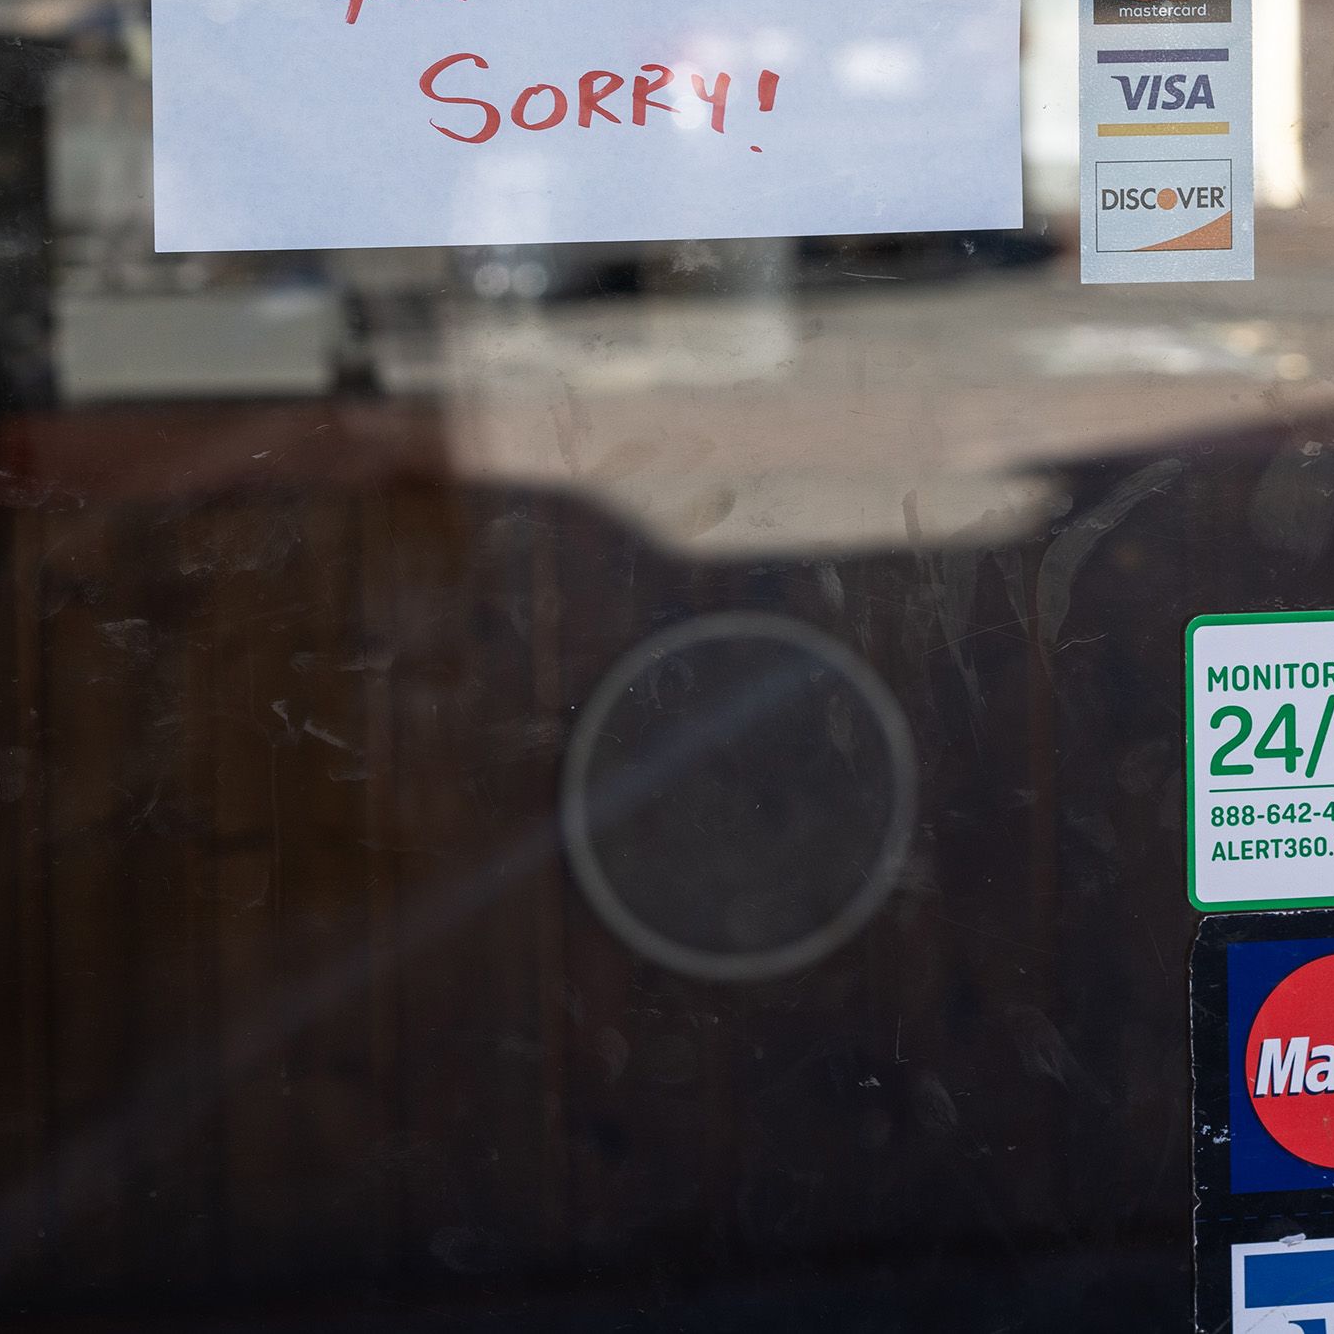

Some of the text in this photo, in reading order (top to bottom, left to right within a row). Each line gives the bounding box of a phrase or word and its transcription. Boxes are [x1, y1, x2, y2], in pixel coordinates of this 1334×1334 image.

[1119, 3, 1207, 18] mastercard
[419, 53, 780, 153] SORRY!
[1111, 74, 1215, 110] VISA
[1101, 186, 1226, 211] DISCOVER
